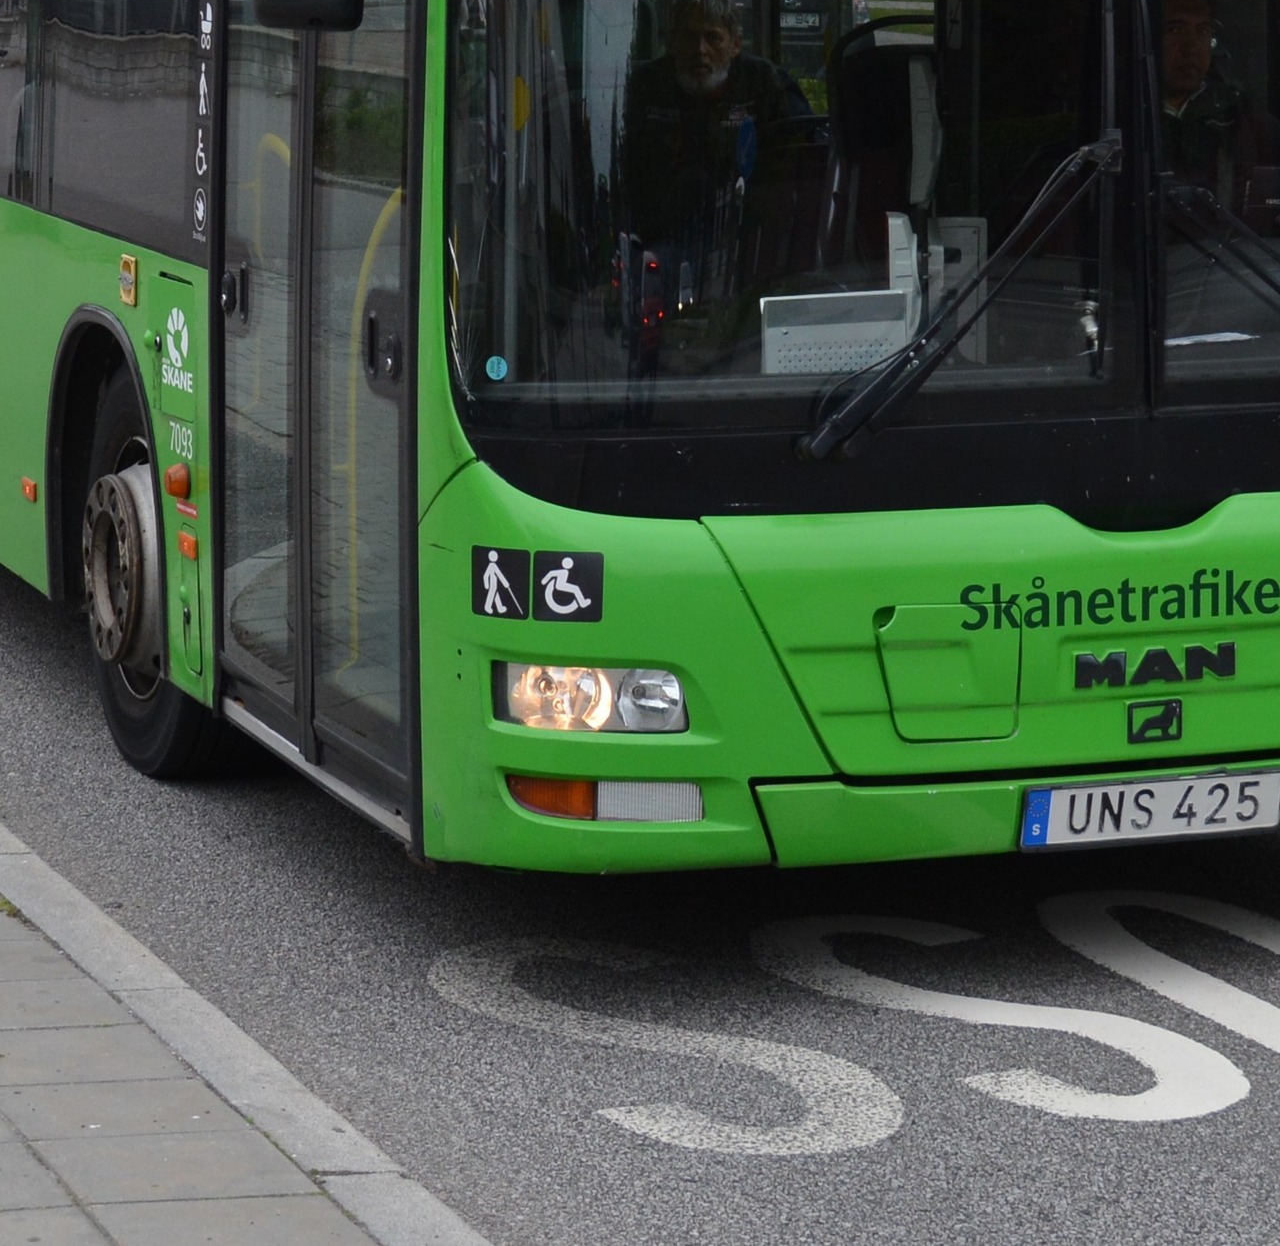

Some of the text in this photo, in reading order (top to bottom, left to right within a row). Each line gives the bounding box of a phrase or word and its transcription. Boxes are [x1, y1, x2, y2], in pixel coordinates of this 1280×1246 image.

[169, 421, 194, 460] 7093
[1073, 641, 1237, 690] MAN
[1030, 780, 1261, 837] S UNS 425
